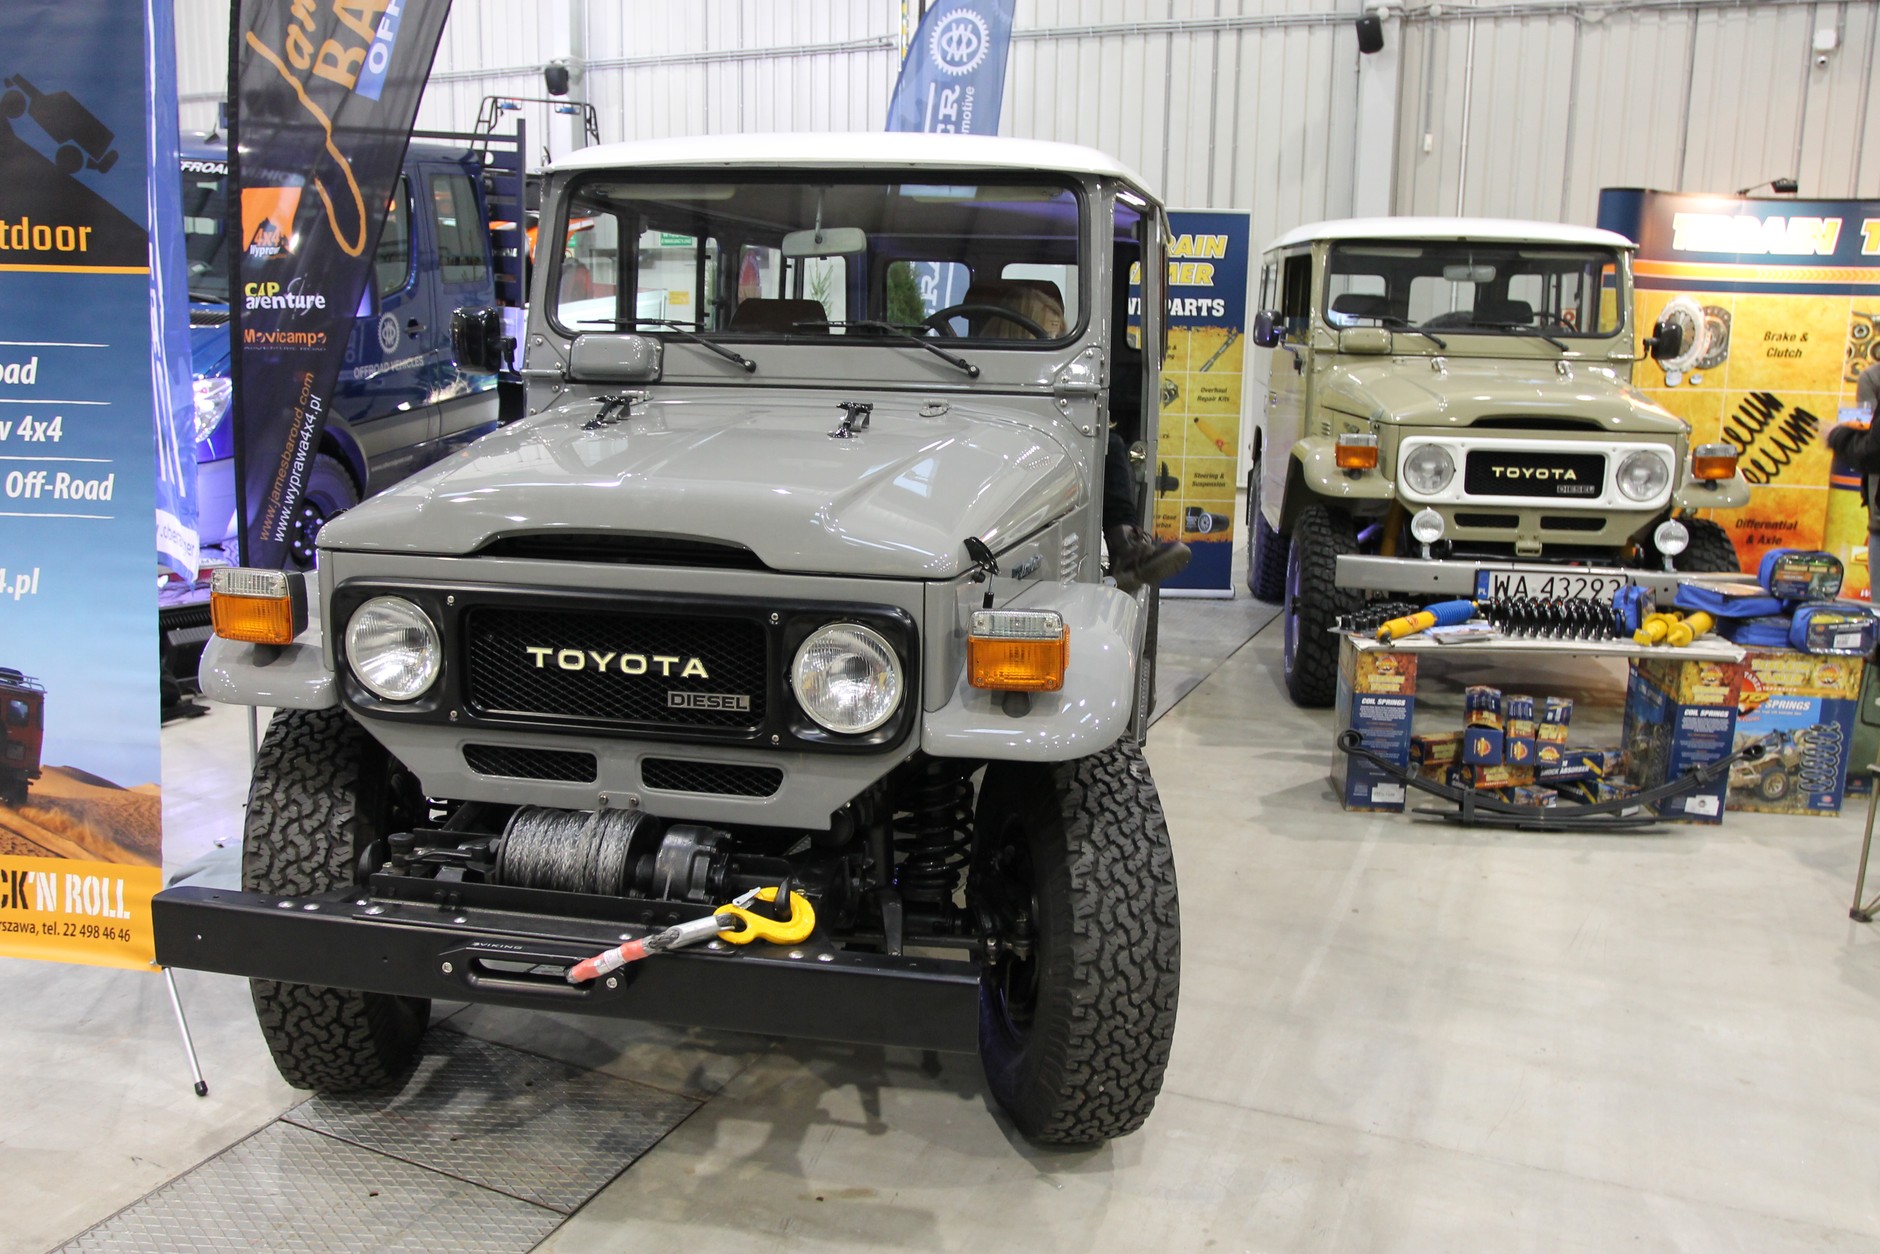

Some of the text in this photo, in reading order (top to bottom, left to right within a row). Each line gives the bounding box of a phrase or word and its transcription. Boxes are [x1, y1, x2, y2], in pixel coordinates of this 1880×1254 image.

[245, 282, 281, 297] CAP
[1168, 298, 1225, 317] ARTS
[1763, 331, 1808, 342] Brake &
[1766, 348, 1803, 359] Clutch
[0, 356, 38, 384] ad
[353, 355, 424, 380] OFFROAD VEHICLES
[16, 415, 63, 442] 4x4
[260, 372, 315, 541] www.jamesbaroud.com
[274, 394, 322, 543] www.wyprawa4x4.pl
[1491, 466, 1577, 480] TOYOTA
[5, 470, 115, 501] Off-Road
[1735, 519, 1798, 530] Differential
[1745, 534, 1783, 545] & Axle
[1494, 575, 1528, 600] WA
[526, 646, 709, 679] TOYOTA
[670, 693, 748, 710] DIESEL
[1361, 697, 1406, 706] COIL SPRINGS
[1765, 699, 1811, 711] SPRINGS
[65, 873, 131, 920] ROLL
[42, 921, 60, 936] tel.
[63, 922, 76, 937] 22
[79, 925, 100, 939] 498
[102, 927, 116, 941] 46
[118, 929, 131, 943] 46
